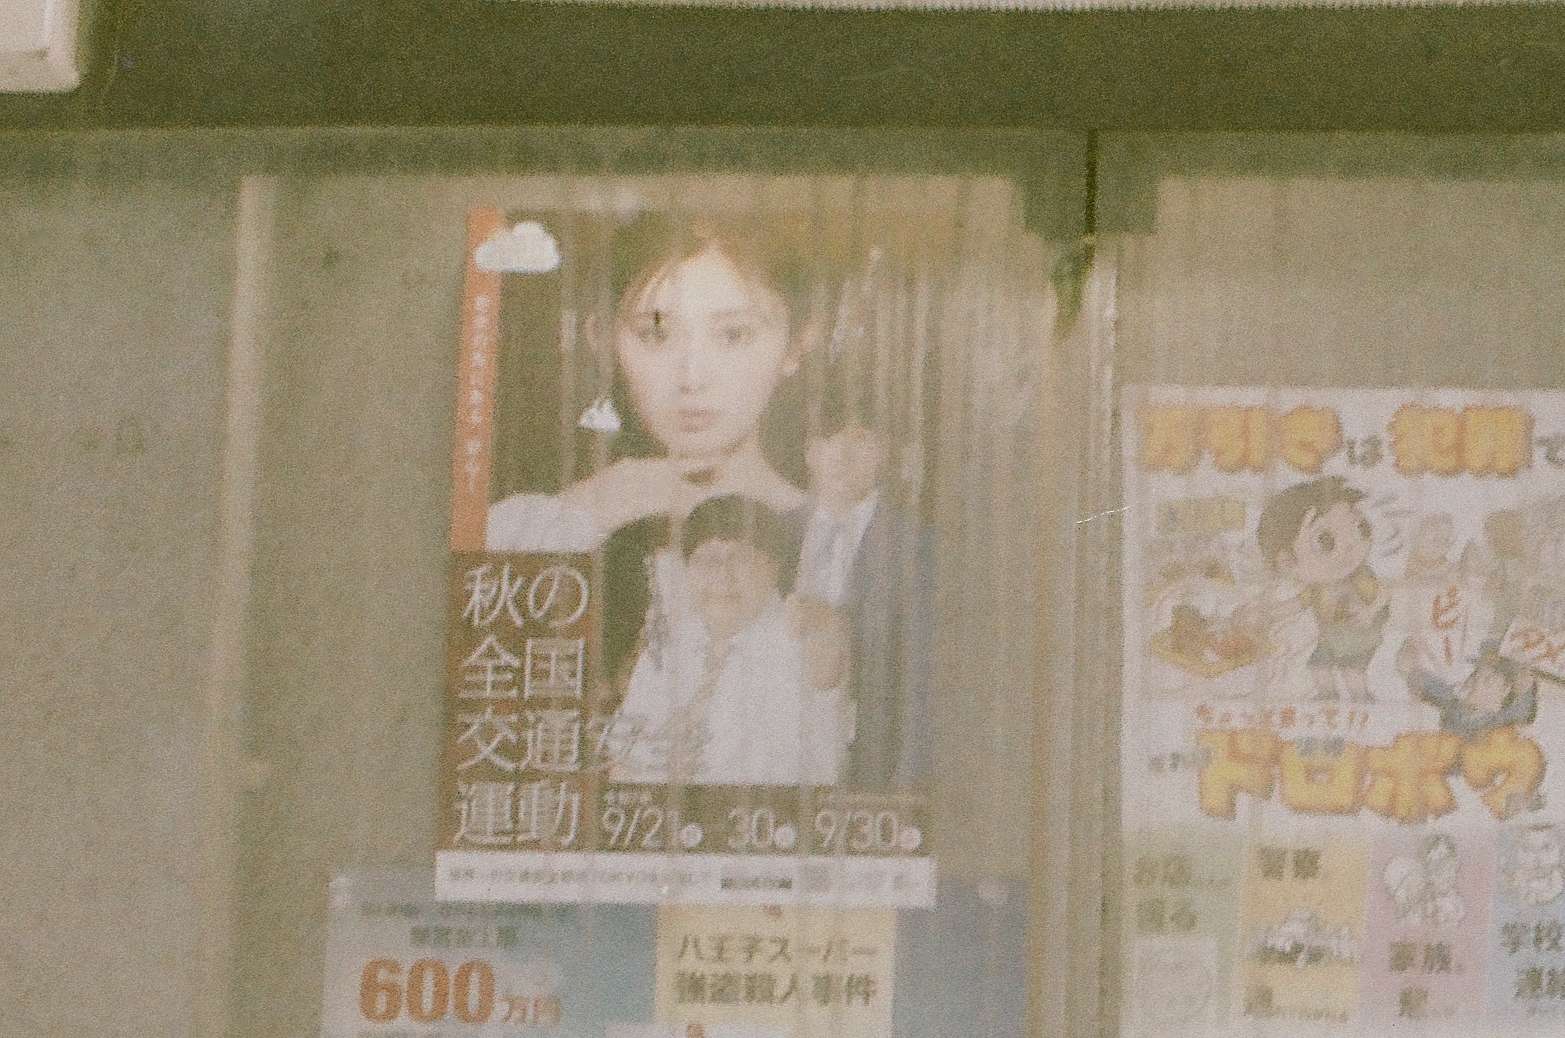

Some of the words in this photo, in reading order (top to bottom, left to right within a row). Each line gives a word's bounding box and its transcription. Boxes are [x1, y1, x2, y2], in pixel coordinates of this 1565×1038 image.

[462, 562, 589, 629] 秋の
[460, 633, 585, 700] 全国
[1197, 727, 1546, 824] ドロボウ
[453, 779, 581, 848] 運動
